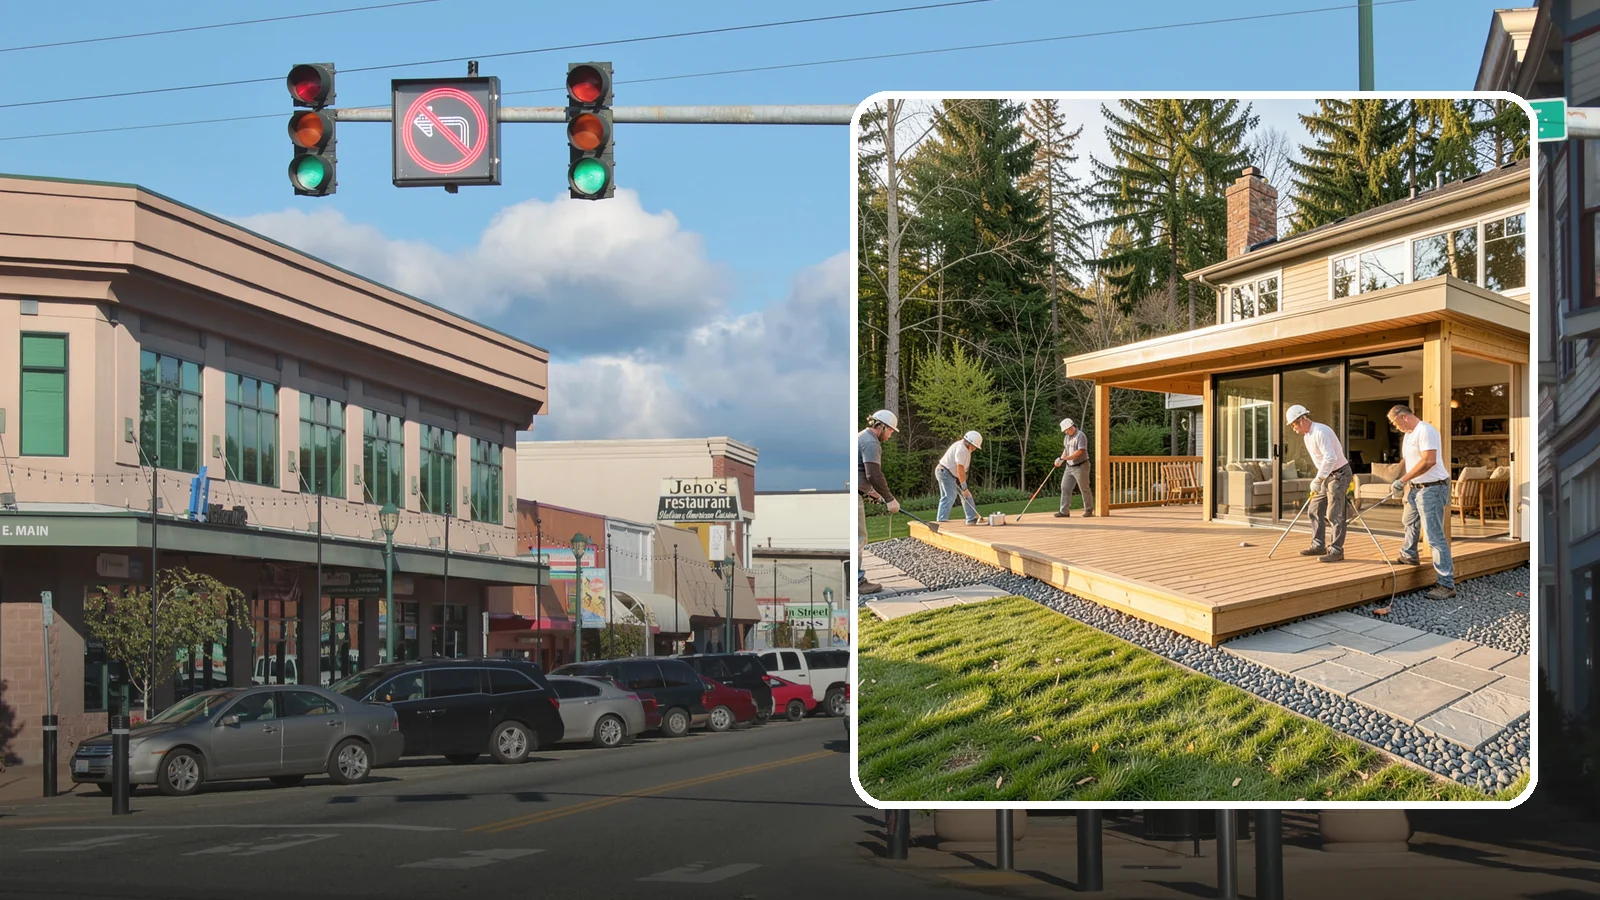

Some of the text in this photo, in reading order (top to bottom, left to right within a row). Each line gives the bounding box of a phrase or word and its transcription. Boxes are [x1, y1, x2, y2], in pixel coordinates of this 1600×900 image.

[670, 480, 727, 494] Jeno's
[665, 496, 731, 509] restaurant
[658, 509, 682, 519] Italian
[686, 509, 714, 519] American
[715, 509, 737, 519] Cuisine
[2, 525, 49, 536] E. MAIN
[797, 607, 829, 616] Street
